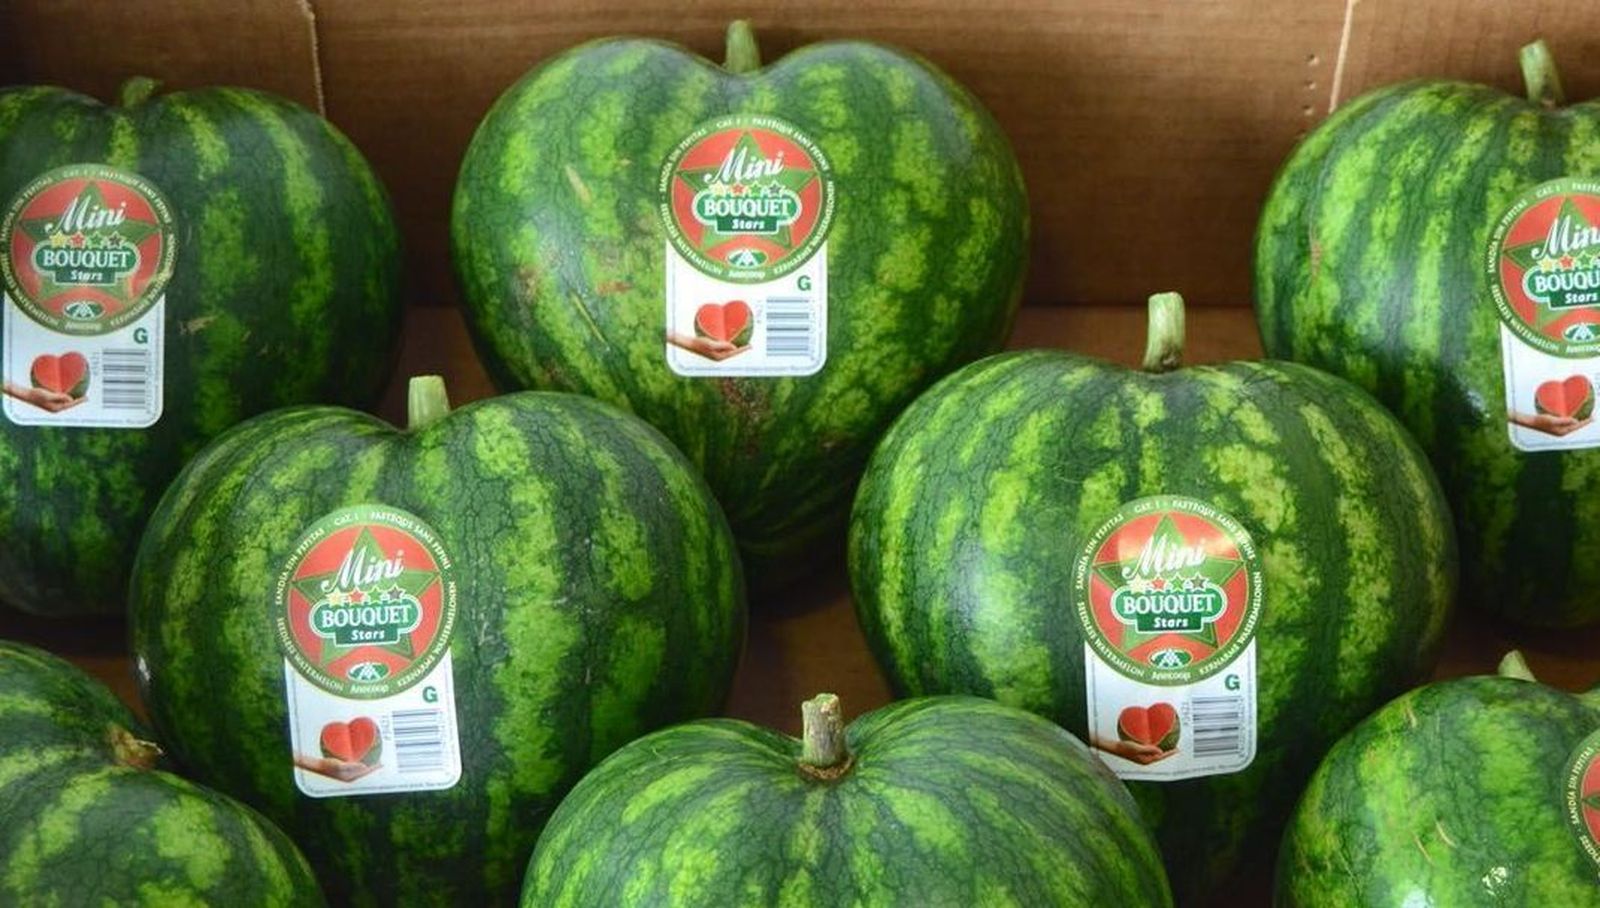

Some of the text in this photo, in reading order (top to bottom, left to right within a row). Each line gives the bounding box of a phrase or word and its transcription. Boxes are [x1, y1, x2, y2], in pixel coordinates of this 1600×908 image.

[704, 147, 784, 184] Mini
[45, 196, 127, 234] Mini
[704, 199, 791, 217] BOUQUET
[732, 218, 765, 231] Stars
[1532, 215, 1600, 261] Min
[43, 251, 131, 269] BOUQUET
[70, 270, 103, 281] Stars
[797, 275, 812, 292] G
[1535, 271, 1600, 293] BOUQU
[1565, 292, 1599, 305] Stars
[134, 328, 149, 344] G
[1122, 533, 1208, 580] Mini
[321, 546, 404, 592] Mini
[1123, 594, 1215, 615] BOUQUET
[322, 604, 412, 629] BOUQUET
[1154, 617, 1189, 629] Stars
[351, 628, 385, 641] Stars
[1093, 638, 1145, 677] WATERMELON
[293, 653, 344, 691] WATERMELON
[1225, 675, 1241, 691] G
[423, 687, 439, 703] G
[1579, 835, 1600, 865] SEEDL
